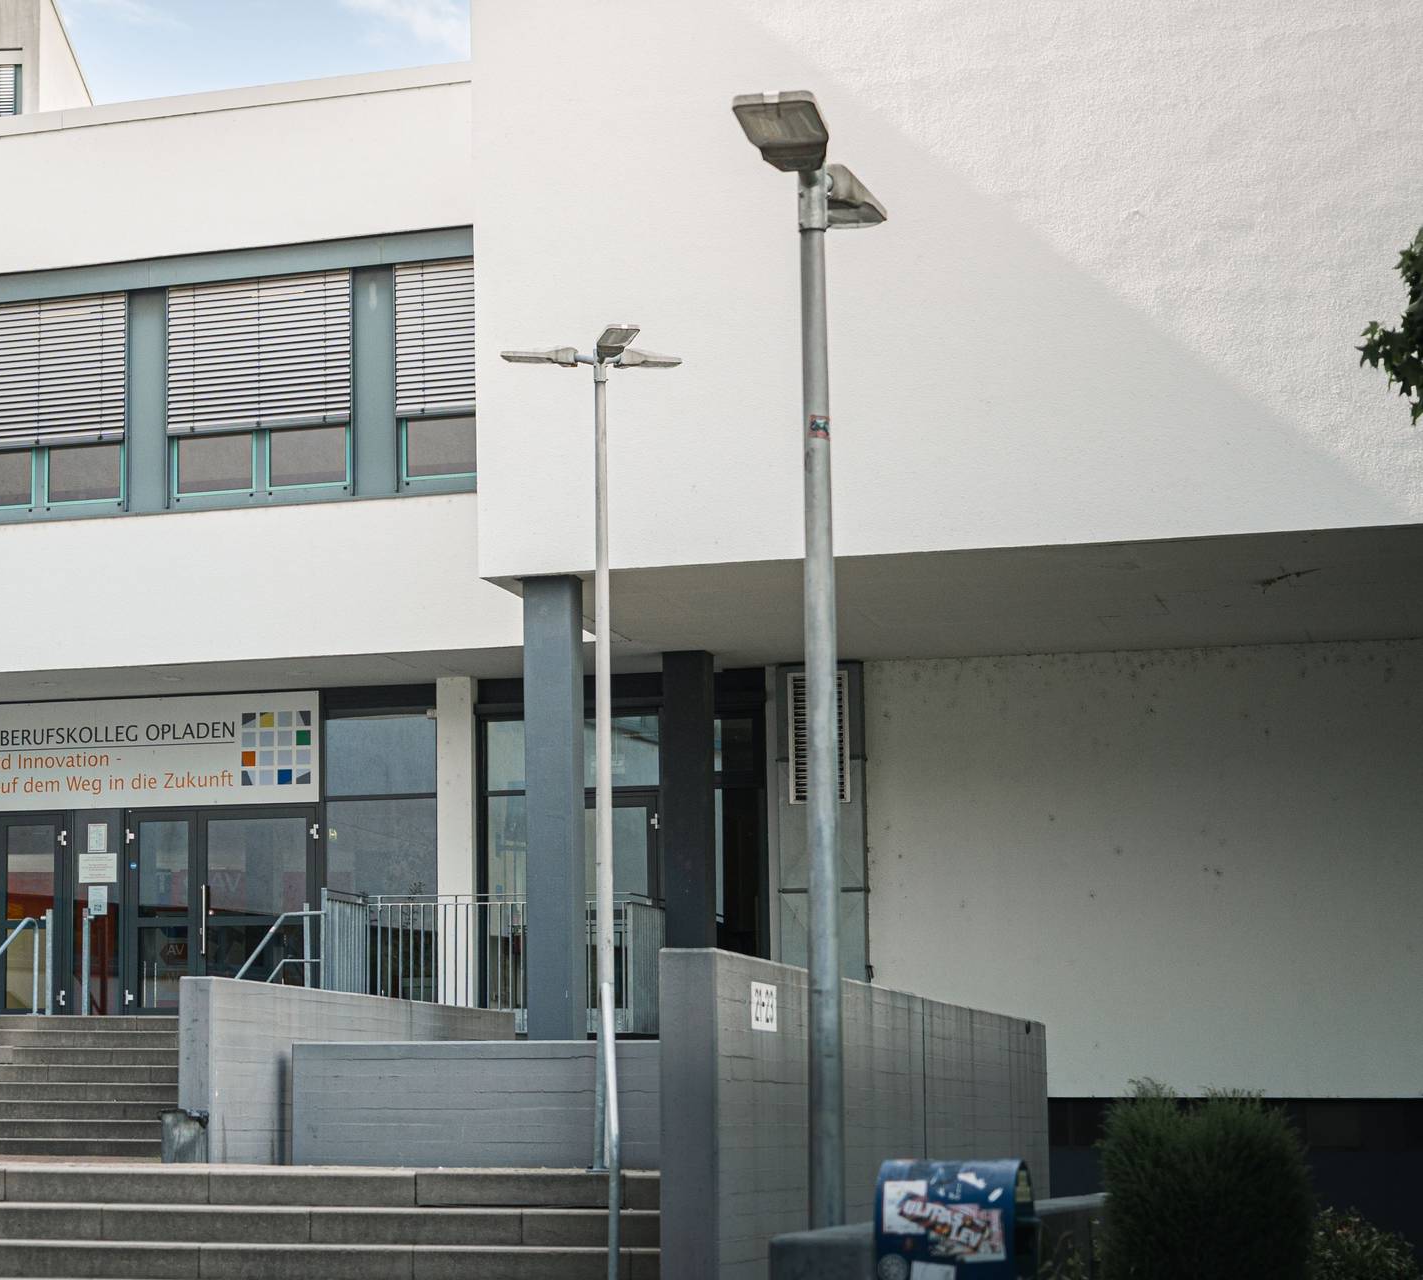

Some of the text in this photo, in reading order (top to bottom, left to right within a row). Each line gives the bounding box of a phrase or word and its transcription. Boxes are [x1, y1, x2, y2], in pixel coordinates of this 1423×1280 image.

[0, 724, 139, 747] BERUFSKOLLEG
[145, 720, 236, 742] OPLADEN
[17, 750, 110, 770] Innovation
[23, 776, 61, 793] dem
[66, 775, 102, 796] Weg
[109, 774, 125, 791] in
[131, 772, 158, 790] die
[163, 769, 234, 790] Zukunft
